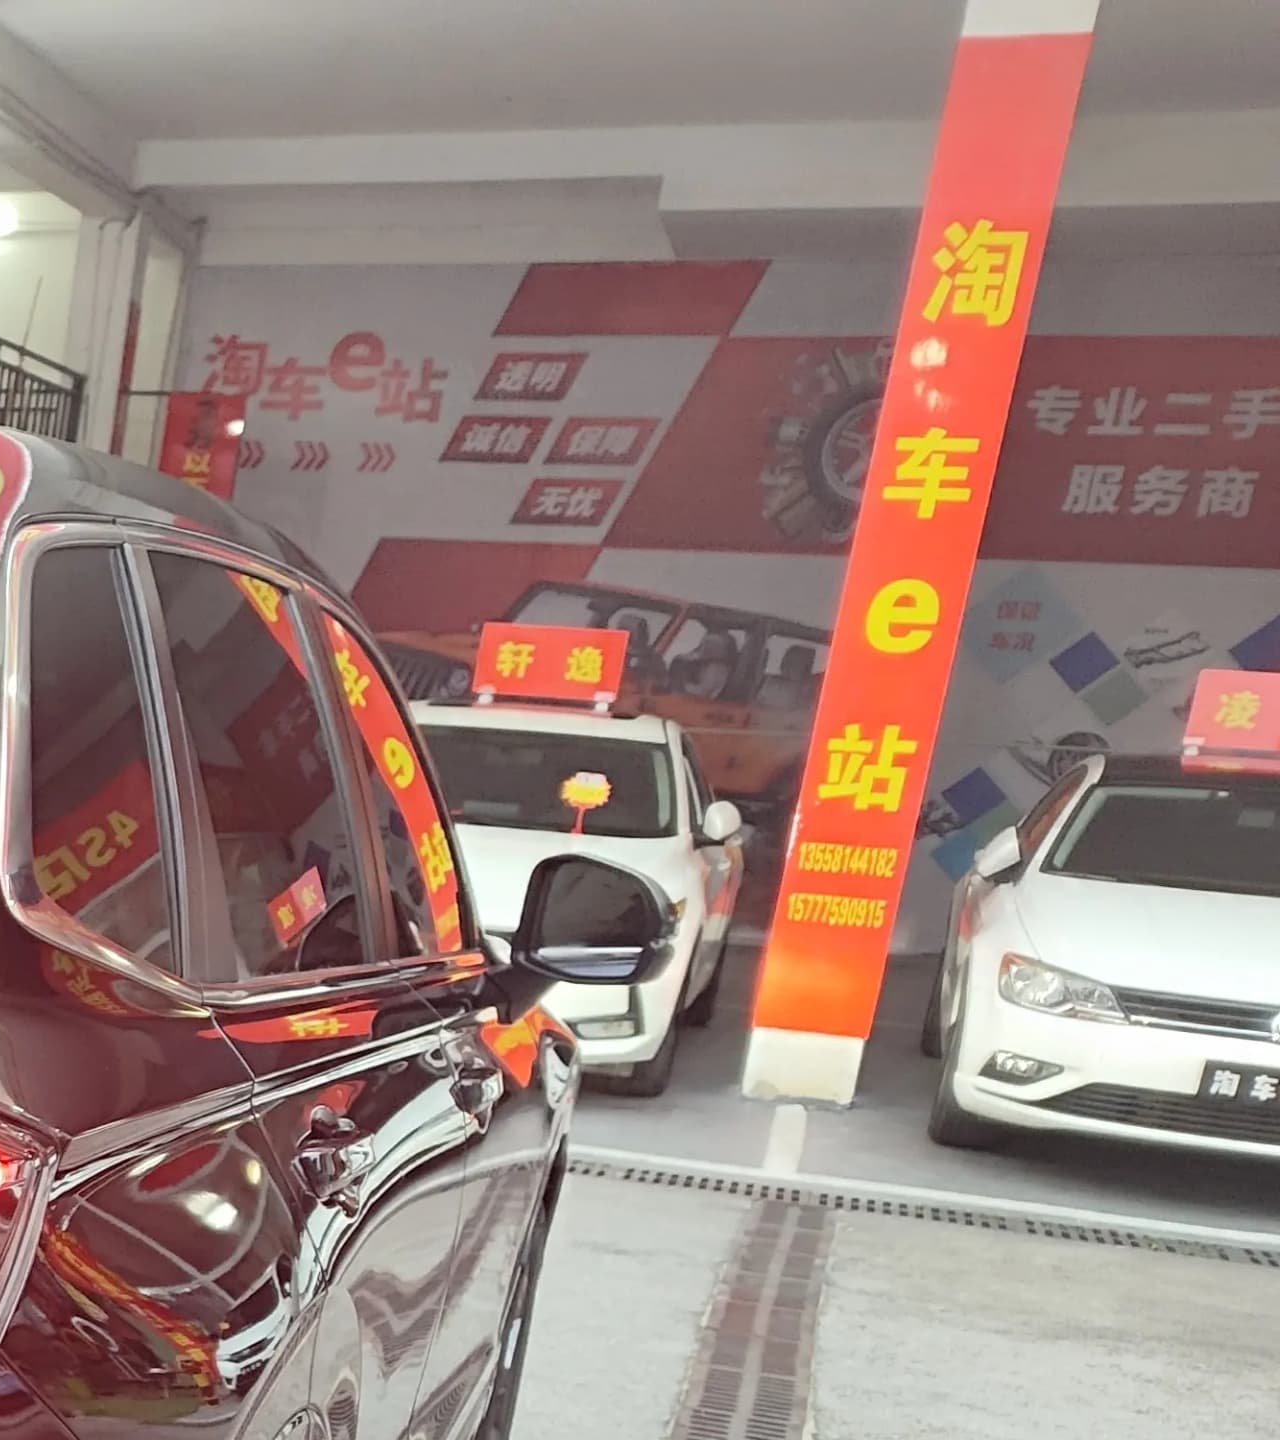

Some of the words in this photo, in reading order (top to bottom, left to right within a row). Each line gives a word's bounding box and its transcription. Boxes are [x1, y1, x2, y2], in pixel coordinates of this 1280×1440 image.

[203, 332, 448, 422] 淘车e站
[494, 360, 569, 392] 透明
[1027, 384, 1280, 440] 专业二手
[818, 218, 1030, 812] 淘车e站
[1060, 464, 1260, 518] 服务商
[496, 640, 604, 684] 轩逸
[799, 841, 898, 878] 13558144182
[788, 892, 888, 928] 15777590915
